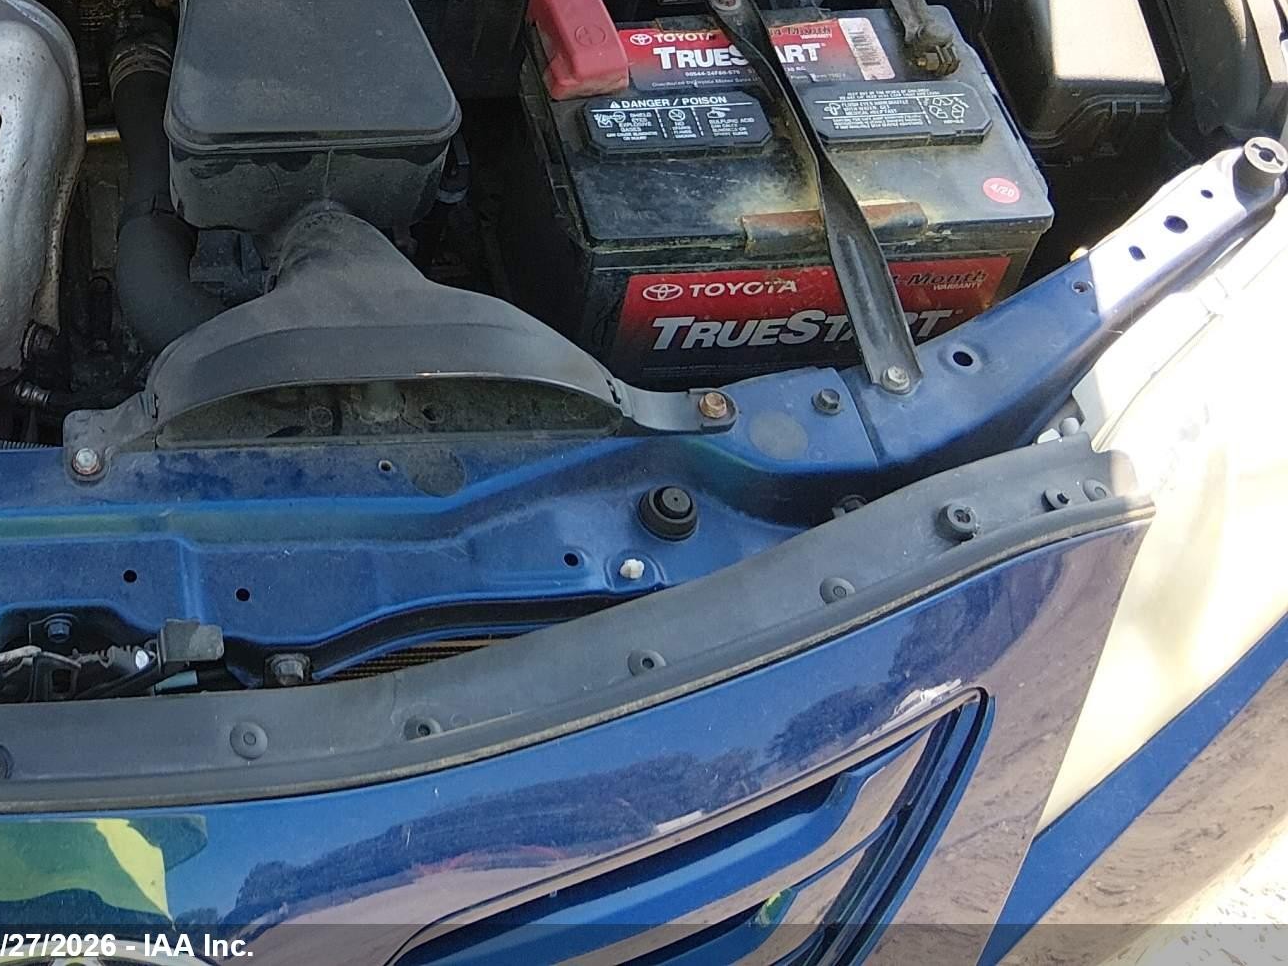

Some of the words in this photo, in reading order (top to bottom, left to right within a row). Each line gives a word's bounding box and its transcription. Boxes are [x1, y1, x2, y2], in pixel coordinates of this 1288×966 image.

[621, 98, 671, 109] DANGER
[673, 98, 679, 106] /
[682, 96, 727, 105] POISON
[990, 184, 1015, 198] 4/20
[690, 280, 798, 298] TOYOTA
